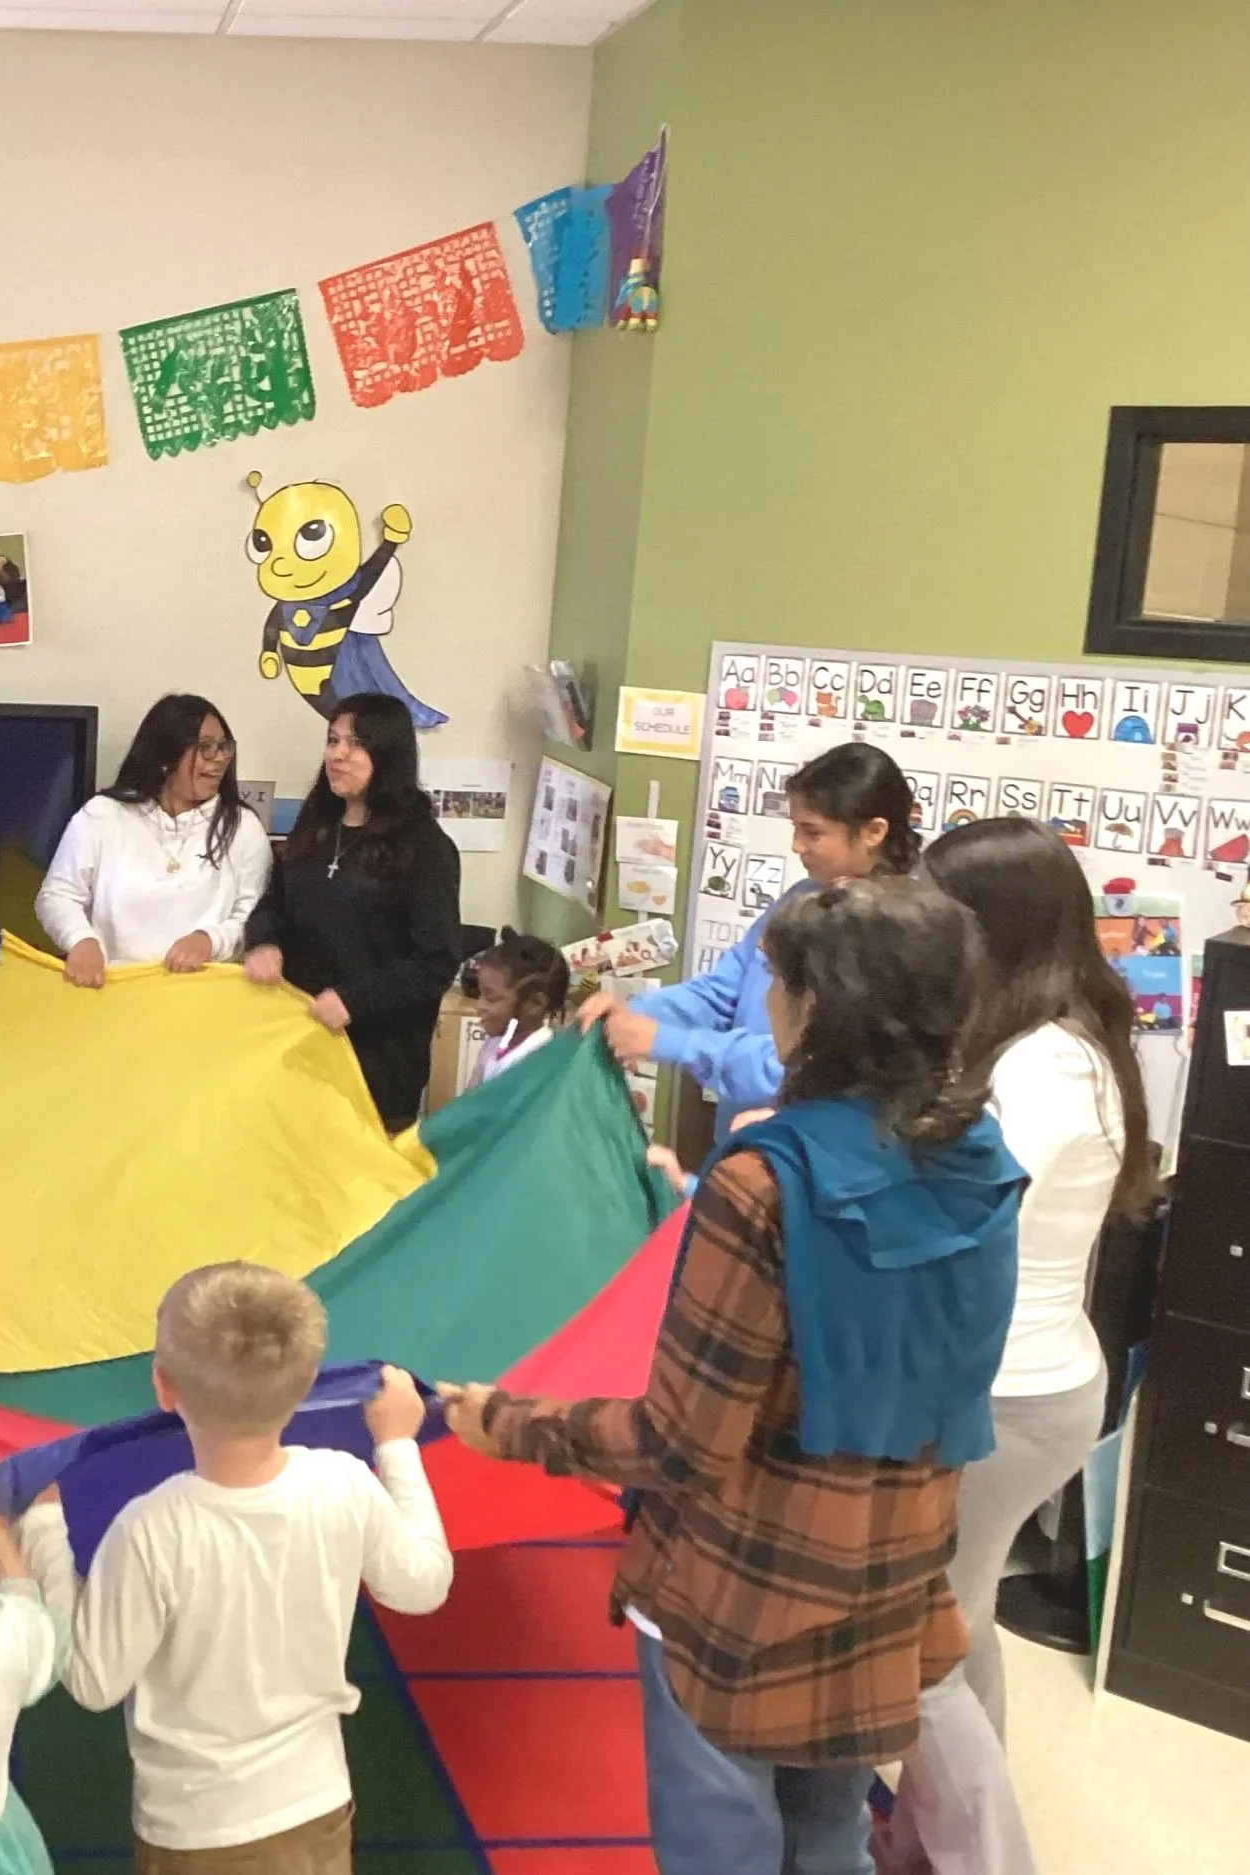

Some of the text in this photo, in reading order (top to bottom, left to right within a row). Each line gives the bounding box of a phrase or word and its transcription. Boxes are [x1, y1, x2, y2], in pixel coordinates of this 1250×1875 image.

[722, 660, 756, 683] Aa
[768, 662, 800, 687] Bb
[812, 666, 845, 692] Cc
[859, 669, 894, 695] Dd
[909, 672, 942, 699] Ee
[959, 677, 994, 703] Ff
[1009, 680, 1046, 713] Gg
[1060, 682, 1098, 710] Hh
[652, 706, 675, 717] OUR
[1122, 686, 1149, 714] Ii
[634, 721, 691, 735] SCHEDULE
[713, 761, 750, 784] Mm
[948, 780, 985, 807] Rr
[1001, 784, 1037, 811] Ss
[1053, 789, 1090, 817] Tt
[1102, 795, 1141, 824] Uu
[1155, 800, 1198, 827] Vv
[1209, 806, 1250, 831] Ww
[709, 846, 737, 878] Yy
[747, 858, 781, 884] Zz
[702, 919, 746, 944] TOD
